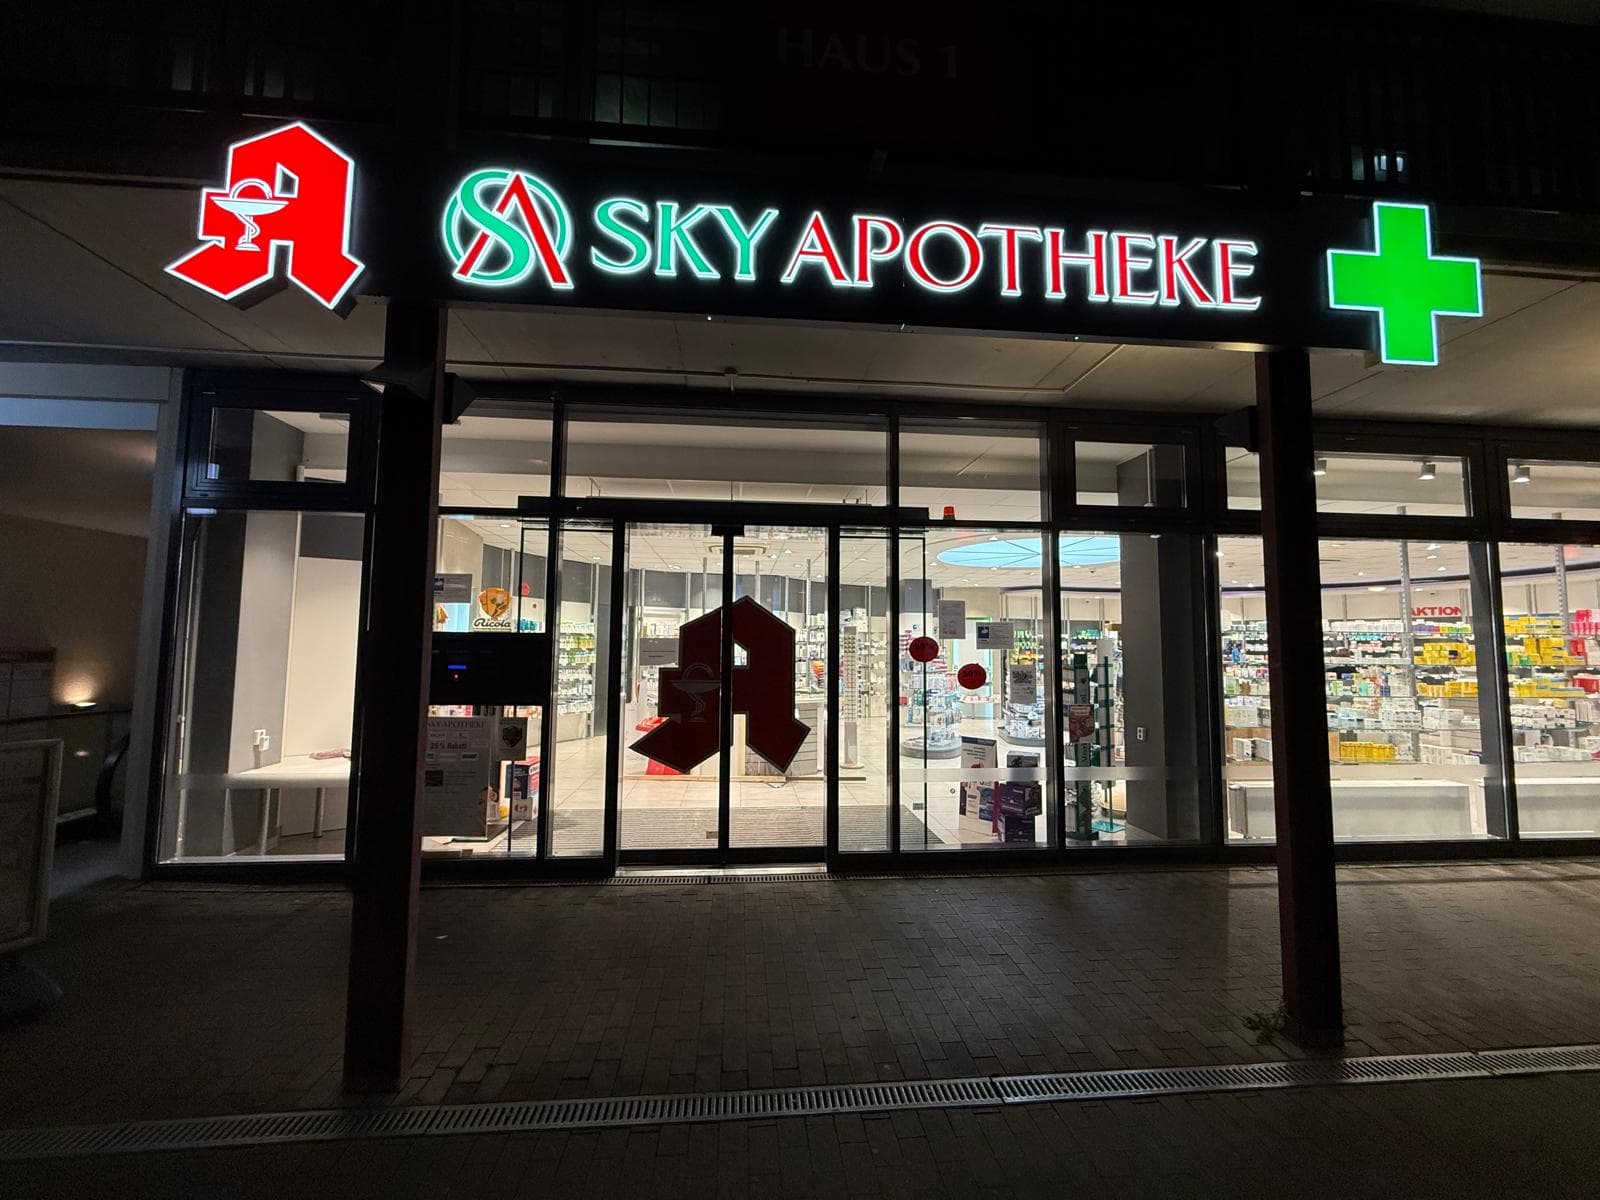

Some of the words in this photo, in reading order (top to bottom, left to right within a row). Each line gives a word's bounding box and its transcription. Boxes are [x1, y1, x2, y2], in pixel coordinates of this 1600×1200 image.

[778, 28, 920, 76] HAUS
[938, 45, 957, 79] 1
[590, 198, 780, 283] SKY
[781, 211, 1262, 311] APOTHEKE
[473, 617, 511, 628] Ricola
